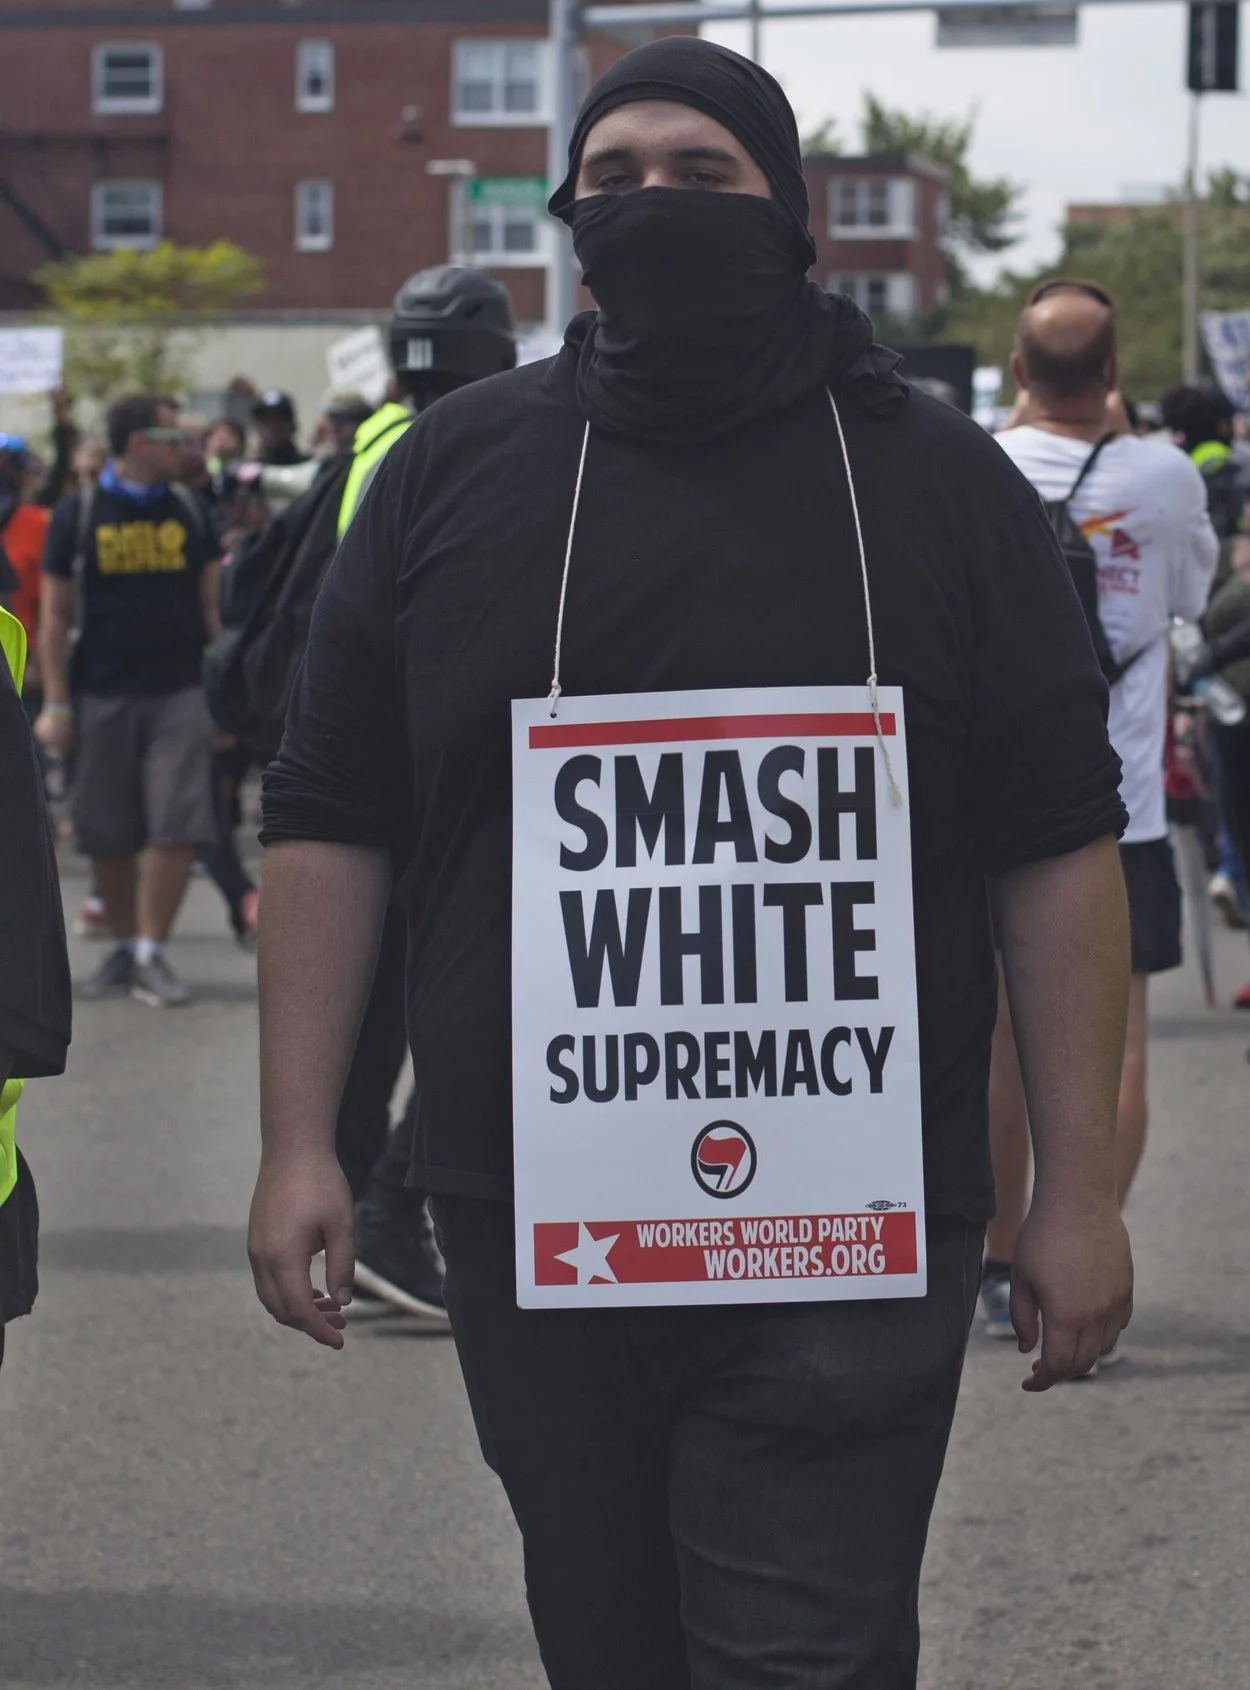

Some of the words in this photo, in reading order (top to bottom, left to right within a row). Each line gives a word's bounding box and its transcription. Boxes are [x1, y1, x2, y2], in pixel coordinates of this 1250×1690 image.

[553, 744, 879, 873] SMASH
[558, 880, 880, 1009] WHITE
[545, 1025, 896, 1105] SUPREMACY
[636, 1222, 736, 1248] WORKERS
[739, 1218, 813, 1245] WORLD
[818, 1215, 885, 1243] PARTY
[703, 1243, 886, 1279] WORKERS.ORG
